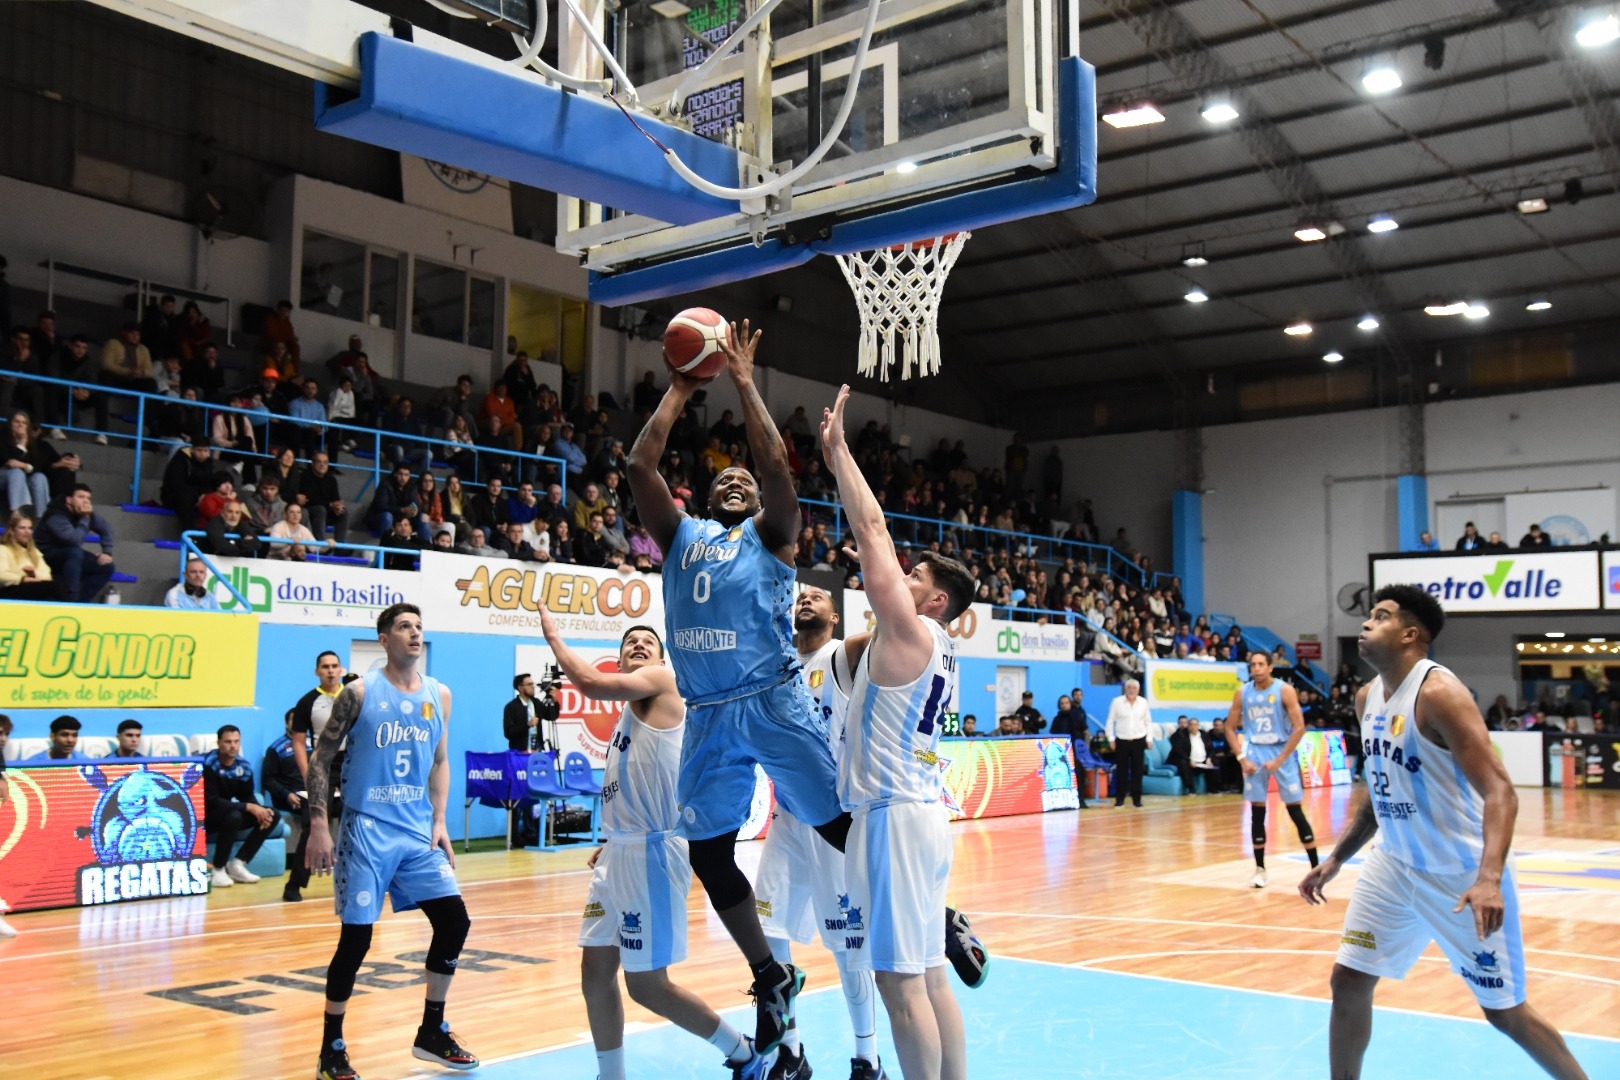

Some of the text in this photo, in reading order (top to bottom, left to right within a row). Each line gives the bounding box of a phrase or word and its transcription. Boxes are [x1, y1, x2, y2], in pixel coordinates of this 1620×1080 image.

[277, 577, 404, 606] don basilio
[455, 564, 651, 619] AGUERCO
[693, 570, 711, 604] 0
[675, 630, 735, 649] ROSAMONTE
[11, 684, 26, 701] el
[31, 688, 70, 703] super
[75, 684, 94, 700] de
[98, 684, 113, 700] la
[1255, 717, 1272, 732] 73
[394, 749, 412, 777] 5
[468, 768, 503, 781] molten
[367, 786, 425, 803] ROSAMONTE
[1371, 770, 1391, 797] 22
[81, 862, 210, 906] REGATAS
